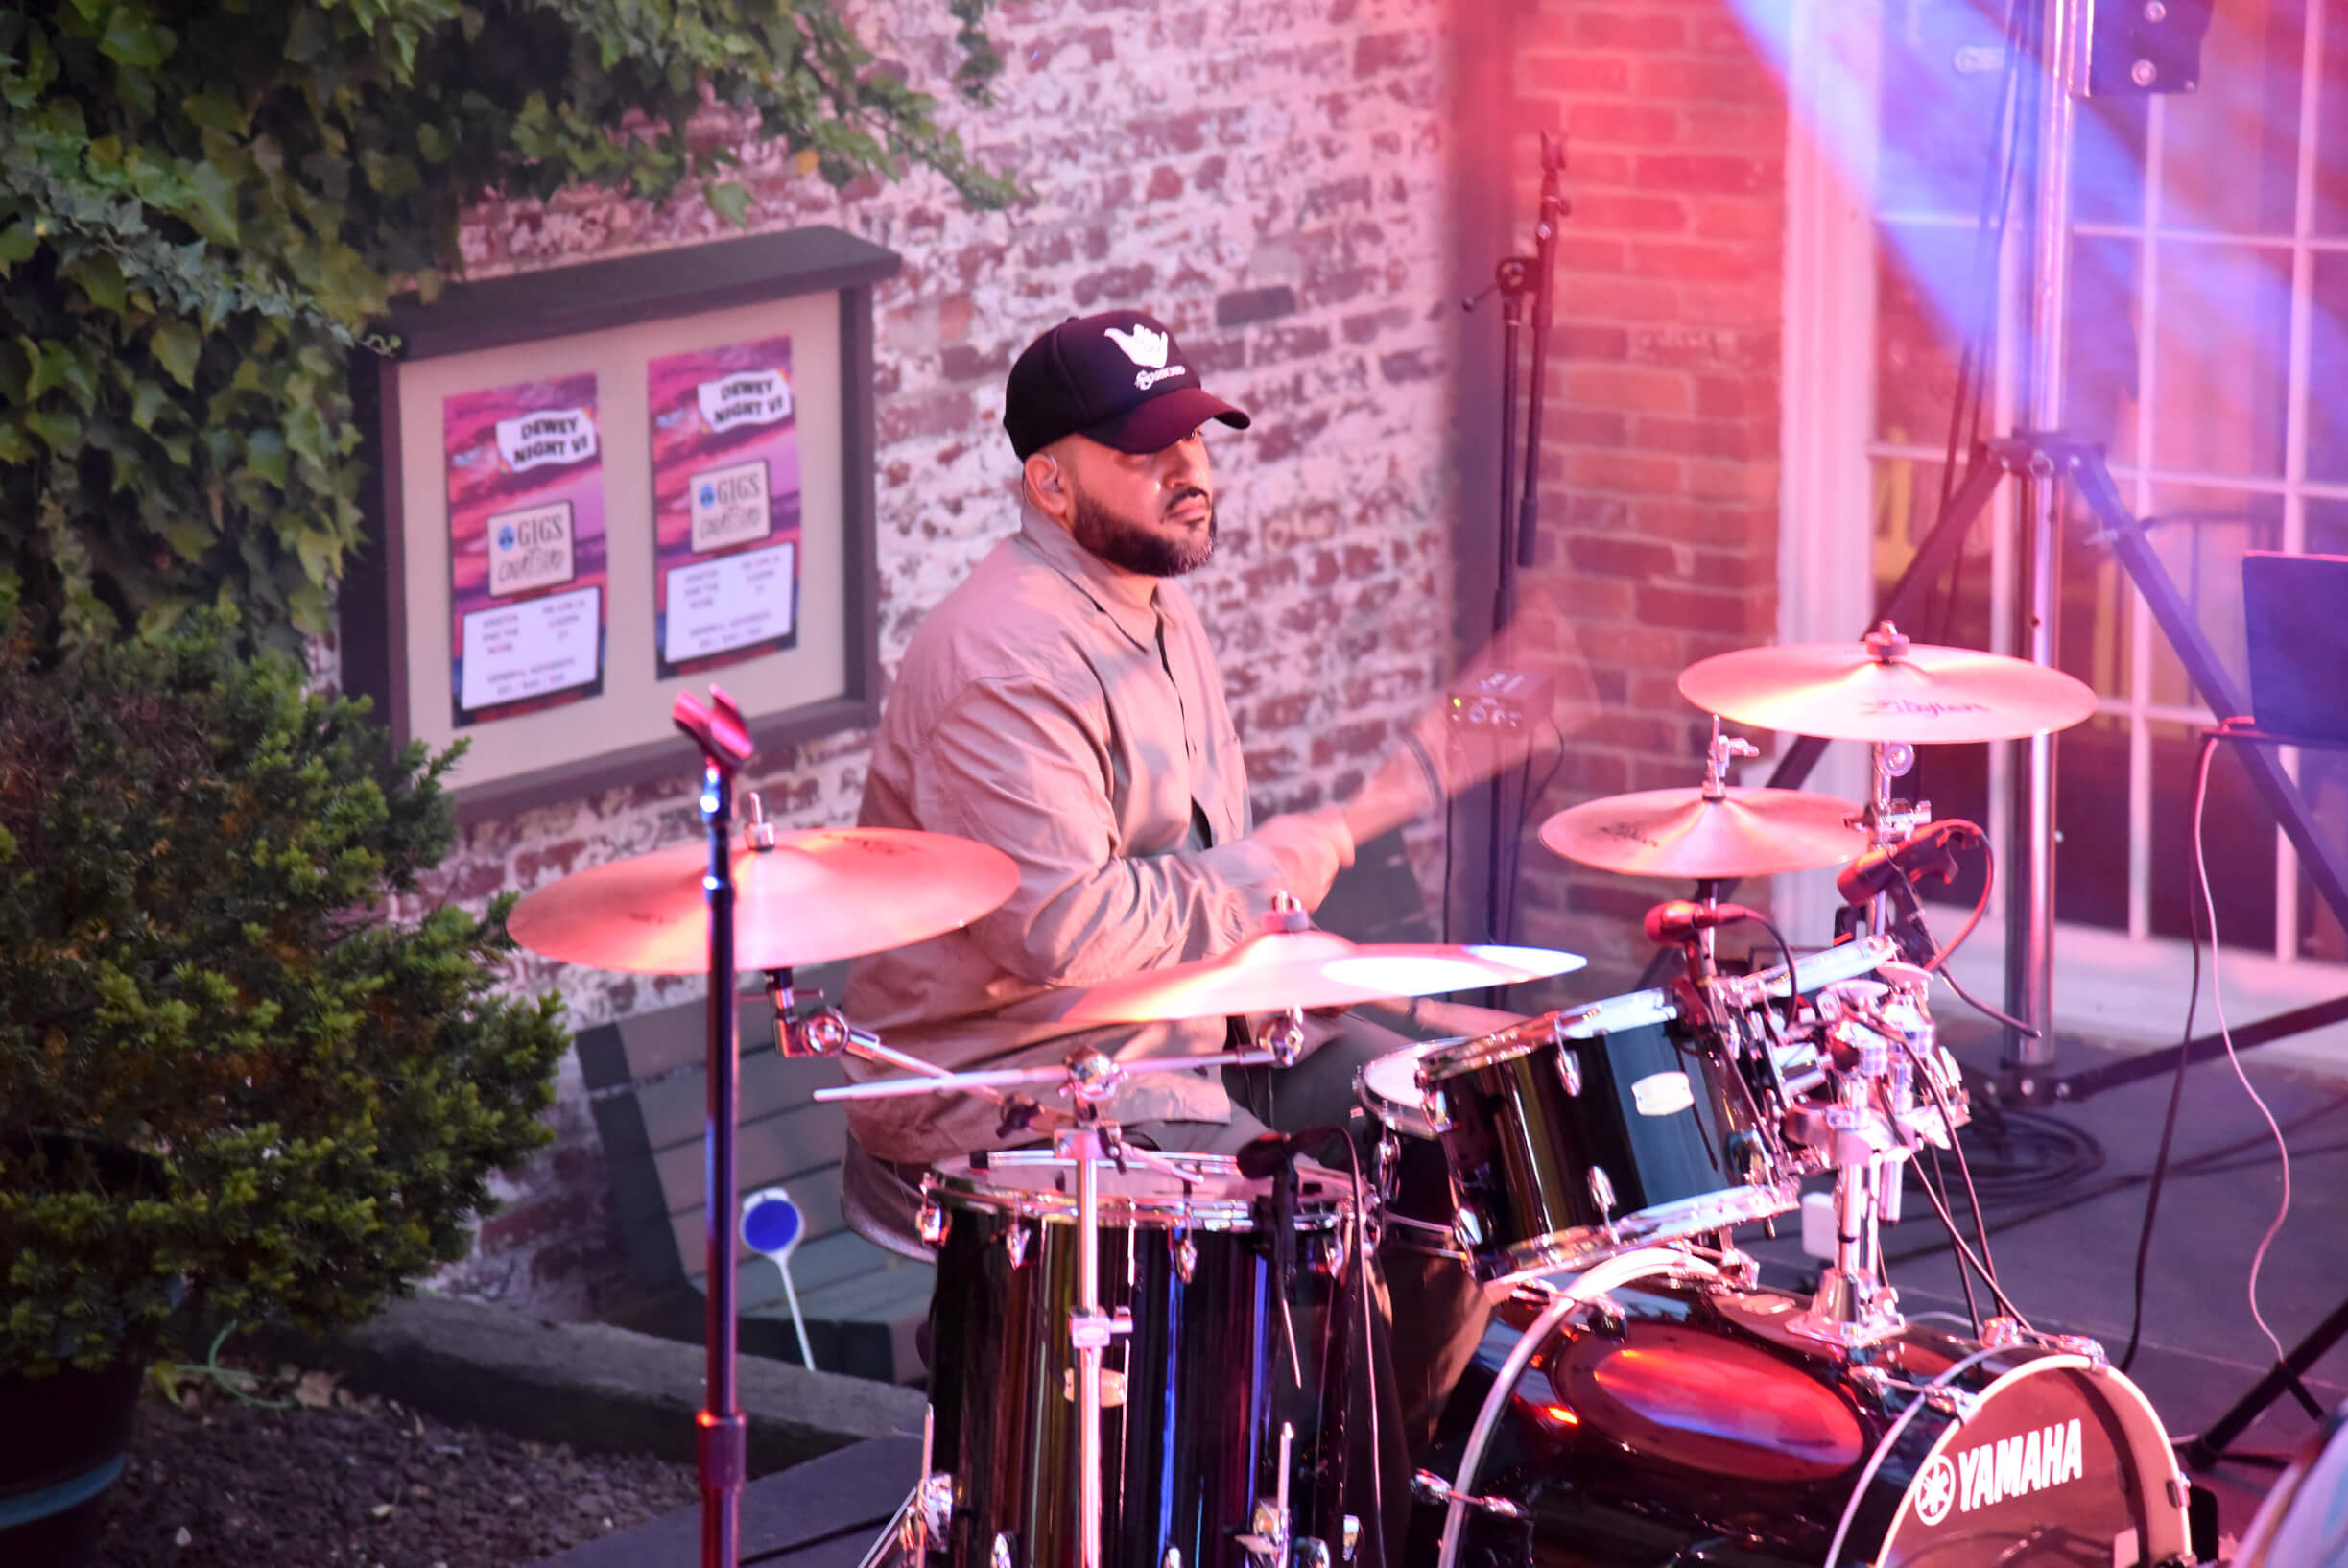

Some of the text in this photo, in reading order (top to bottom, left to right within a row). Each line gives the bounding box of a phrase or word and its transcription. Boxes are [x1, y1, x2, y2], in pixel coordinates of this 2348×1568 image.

[722, 378, 775, 401] DEWEY
[714, 400, 763, 423] NIGHT
[521, 416, 579, 440] DEWEY
[513, 439, 567, 463] NIGHT
[717, 472, 761, 507] GIGS
[517, 513, 564, 548] GIGS
[1957, 1417, 2083, 1513] YAMAHA
